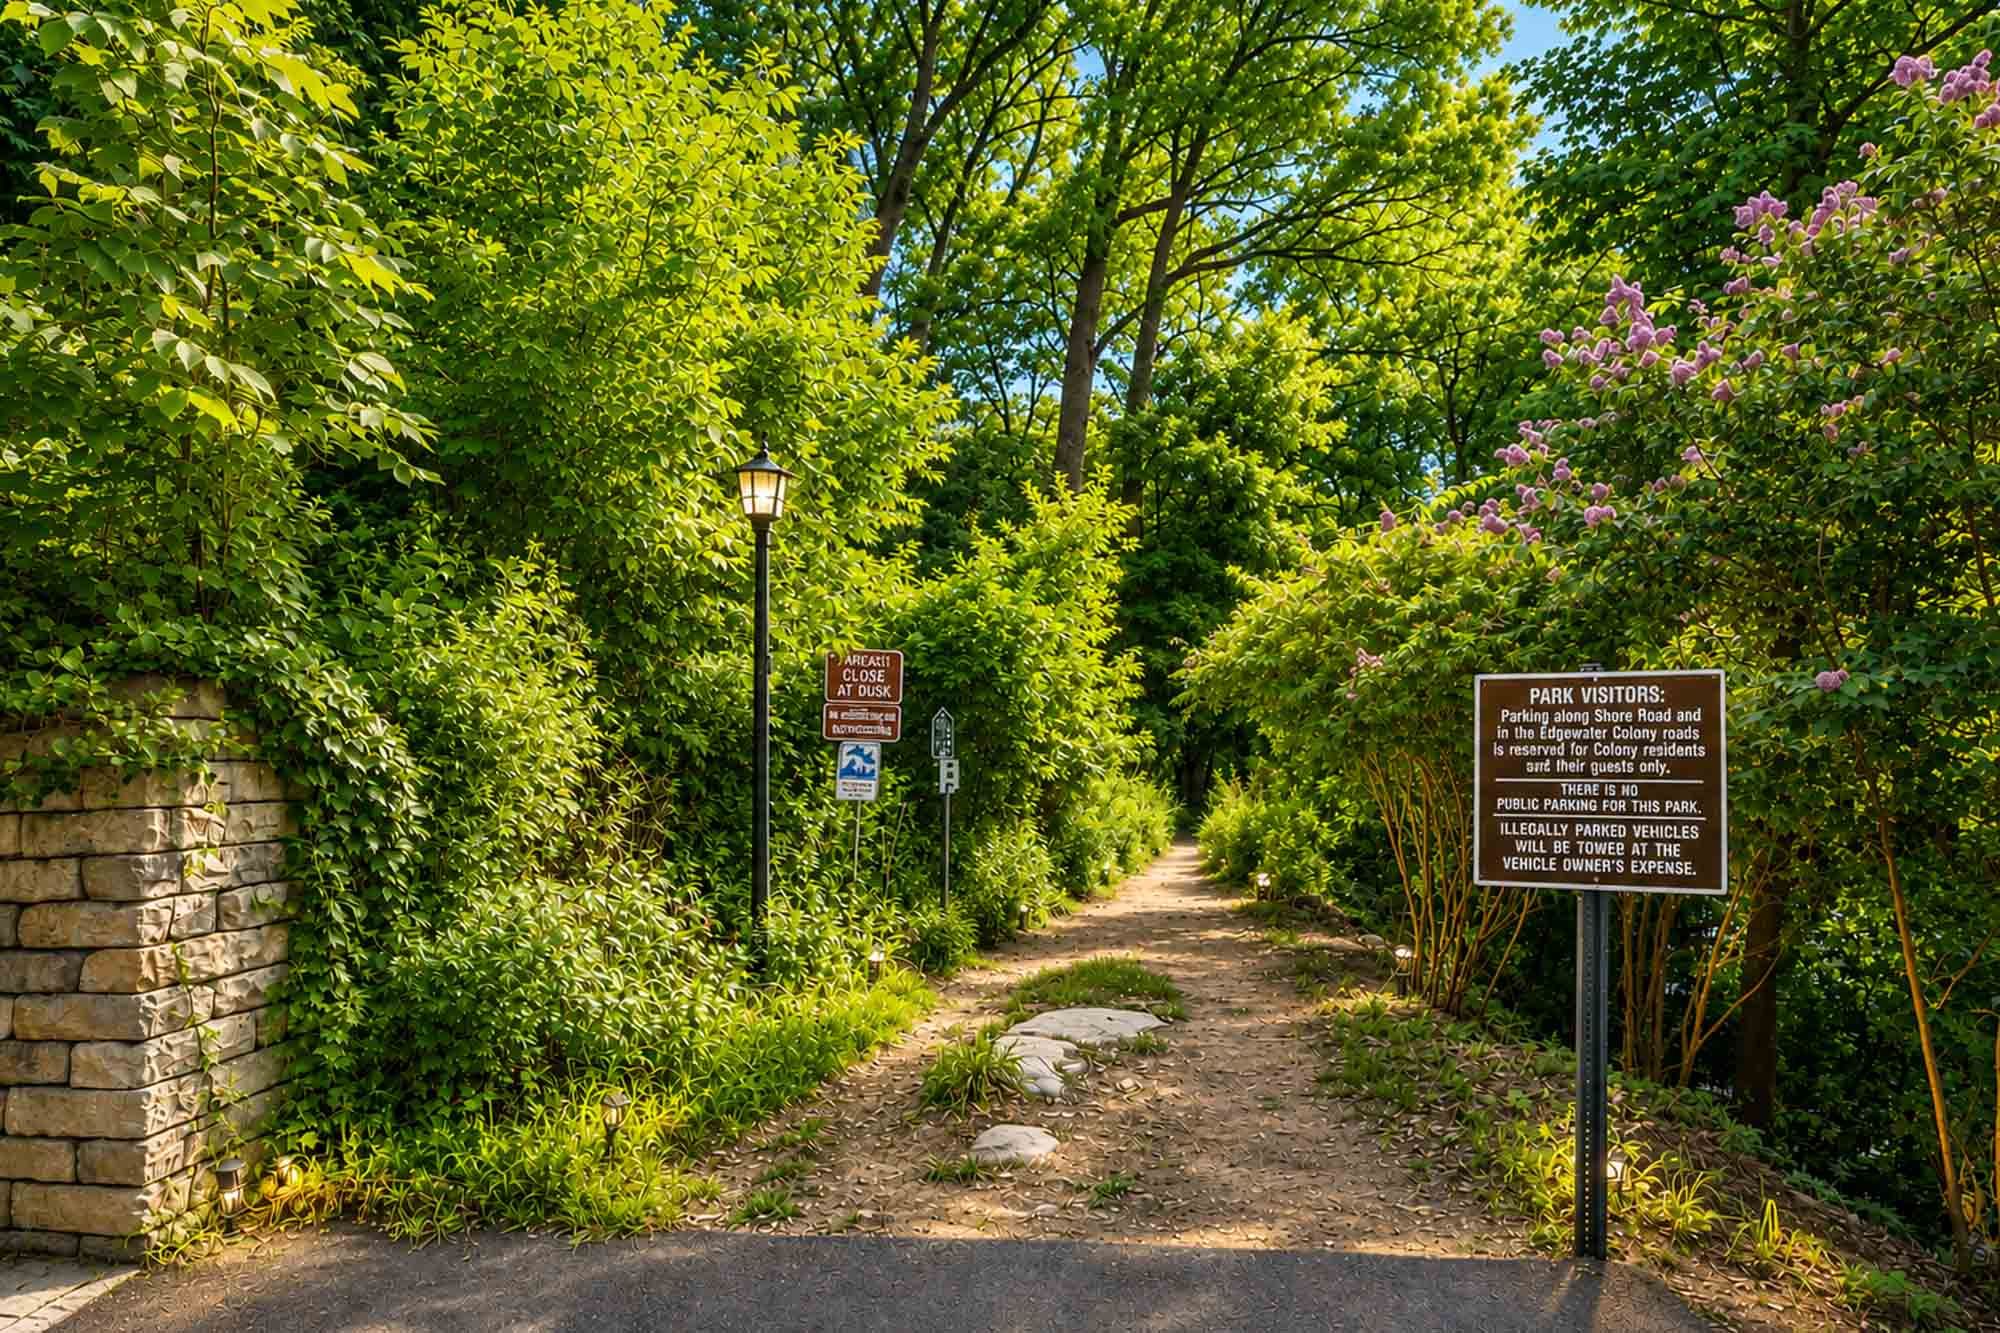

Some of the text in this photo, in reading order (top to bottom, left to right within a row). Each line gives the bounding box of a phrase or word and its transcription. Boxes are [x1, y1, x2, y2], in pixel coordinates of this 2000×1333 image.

[842, 668, 886, 683] CLOSE
[837, 684, 892, 698] AT DUSK
[1530, 685, 1665, 705] PARK VISITORS:
[1501, 708, 1702, 726] Parking along Shore Road and
[1497, 725, 1700, 742] in the Edgewater Colony roads
[1509, 742, 1565, 756] reserved
[1570, 742, 1589, 756] for
[1593, 742, 1638, 760] Colony
[1643, 742, 1706, 757] residents
[1556, 759, 1586, 773] their
[1590, 760, 1635, 776] guests
[1639, 760, 1671, 776] only.
[1561, 783, 1639, 797] THERE IS NO
[1497, 798, 1703, 815] PUBLIC PARKING FOR THIS PARK.
[1500, 822, 1700, 840] ILLEGALLY PARKED VEHICLES
[1515, 839, 1547, 853] WILL
[1553, 840, 1571, 854] BE
[1631, 842, 1649, 857] AT
[1655, 843, 1681, 857] THE
[1503, 856, 1697, 876] VEHICLE OWNER'S EXPENSE.
